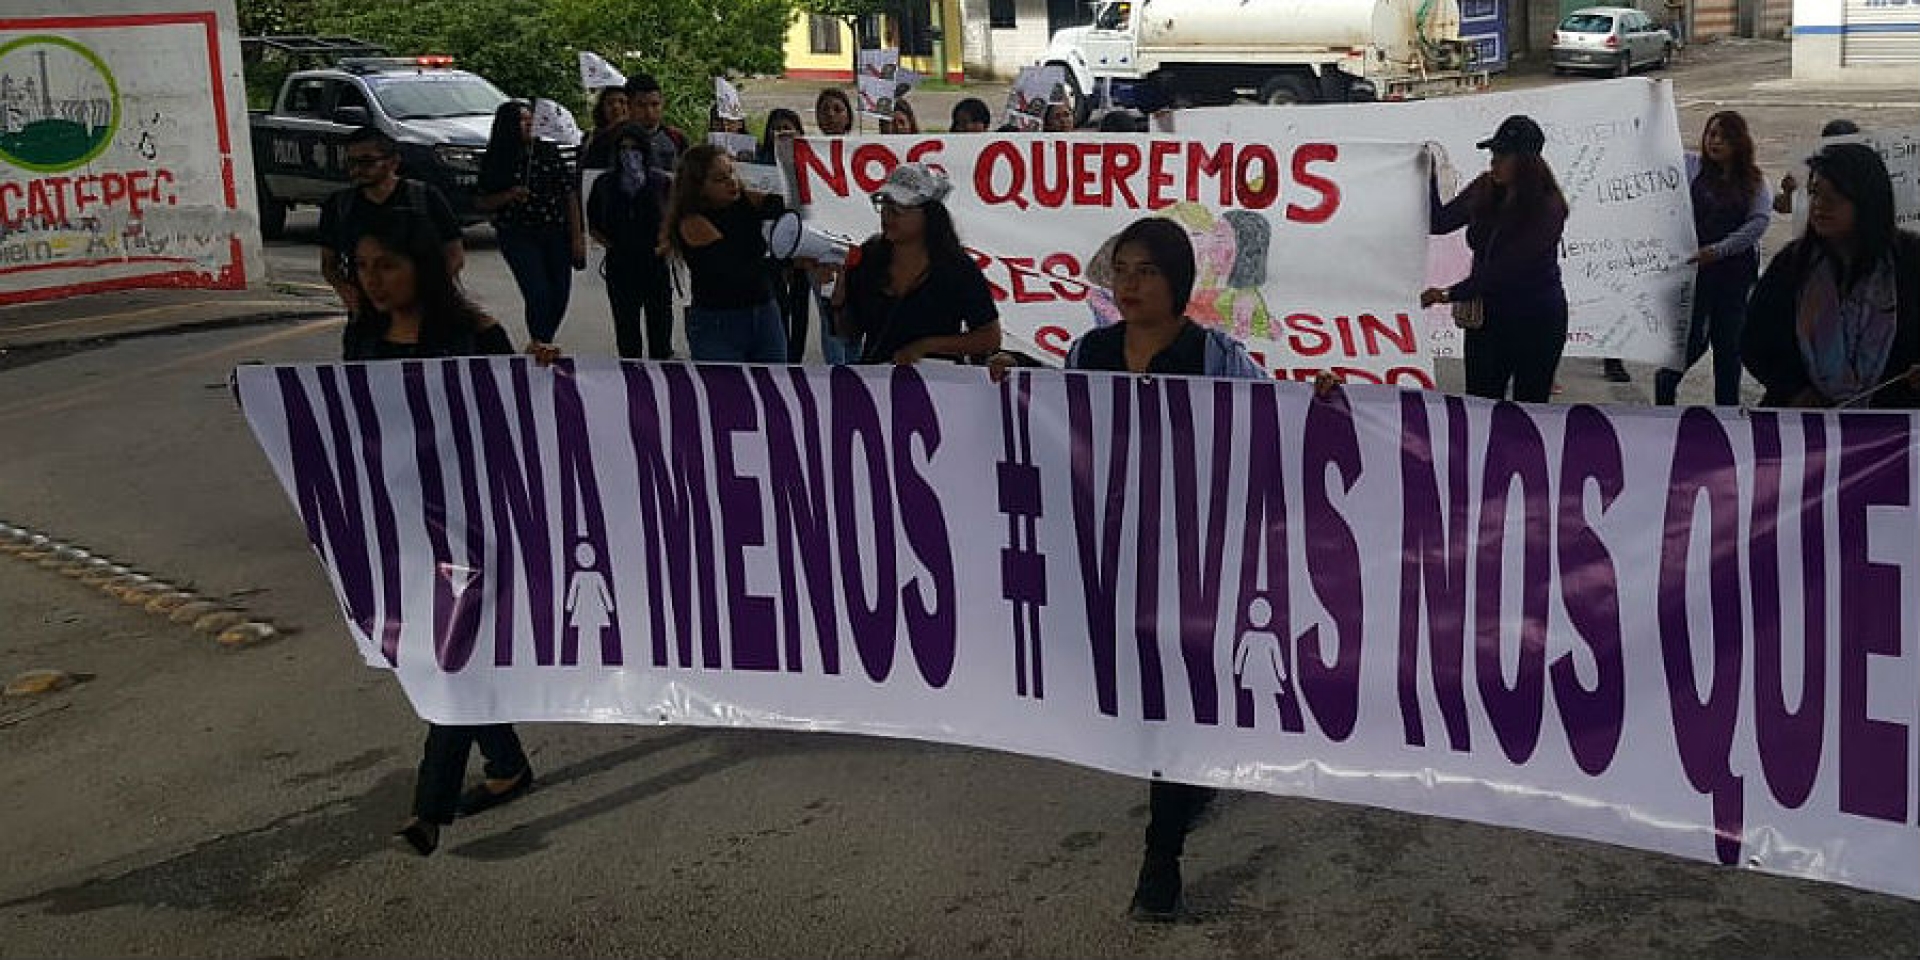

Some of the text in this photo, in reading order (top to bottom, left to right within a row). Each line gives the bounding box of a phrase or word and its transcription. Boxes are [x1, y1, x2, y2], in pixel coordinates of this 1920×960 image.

[974, 140, 1341, 223] QUEREMOS
[1597, 165, 1681, 204] LIBERTAD
[1283, 313, 1416, 357] SIN
[275, 364, 402, 668] NI
[402, 358, 624, 674] UNA
[620, 361, 957, 688] MENOS
[1398, 390, 1625, 778] NOS
[1657, 405, 1920, 865] QUE
